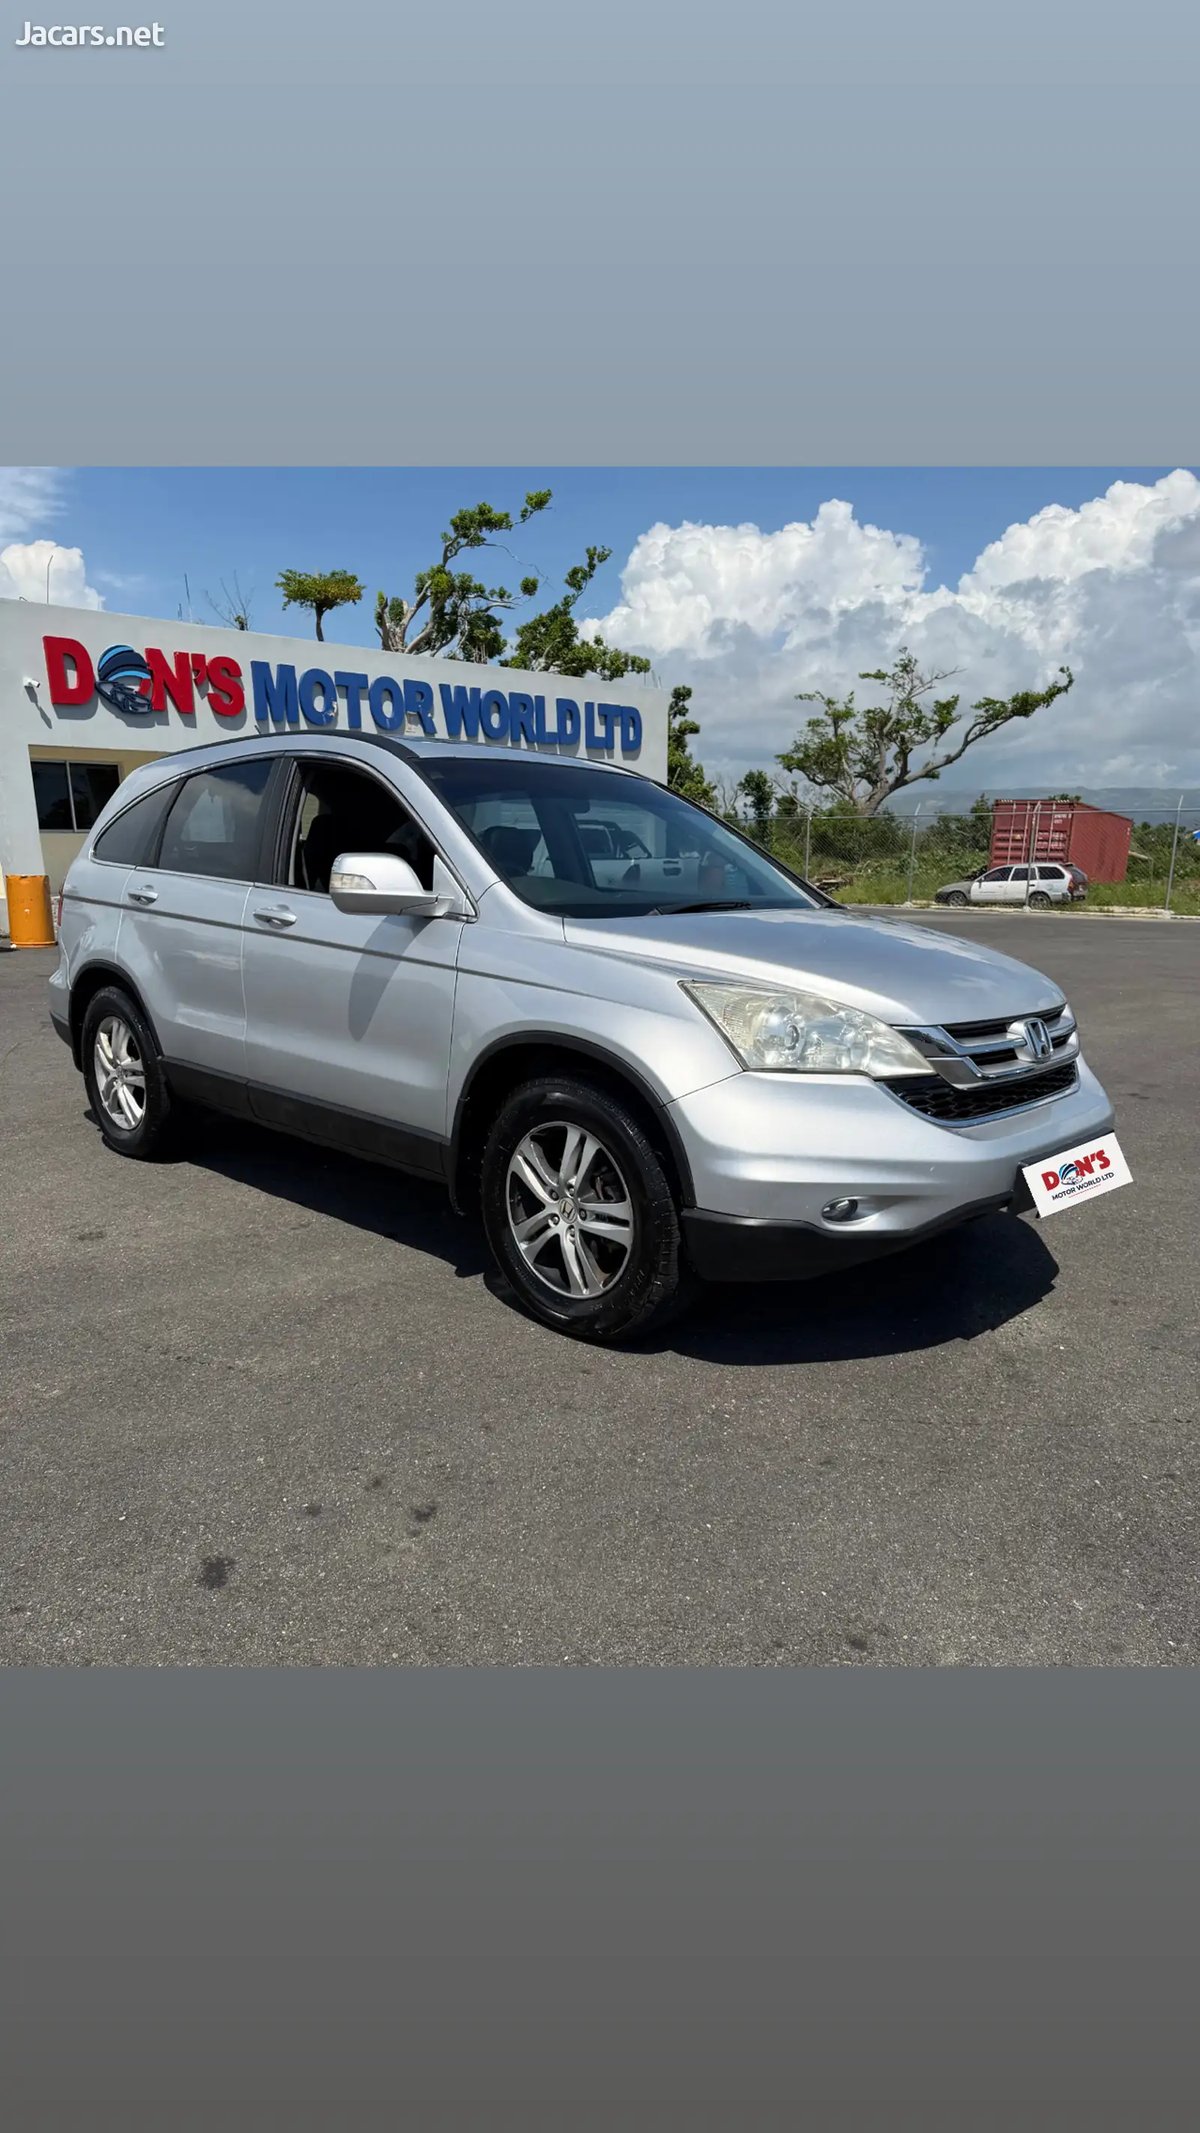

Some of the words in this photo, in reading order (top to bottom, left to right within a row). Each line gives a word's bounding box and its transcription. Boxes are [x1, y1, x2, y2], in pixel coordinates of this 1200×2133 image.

[250, 660, 437, 735] MOTOR
[438, 683, 581, 745] WORLD
[584, 701, 642, 752] LTD
[1052, 1187, 1076, 1200] MOTOR
[1076, 1177, 1101, 1190] WORLD
[1102, 1172, 1115, 1181] LTD
